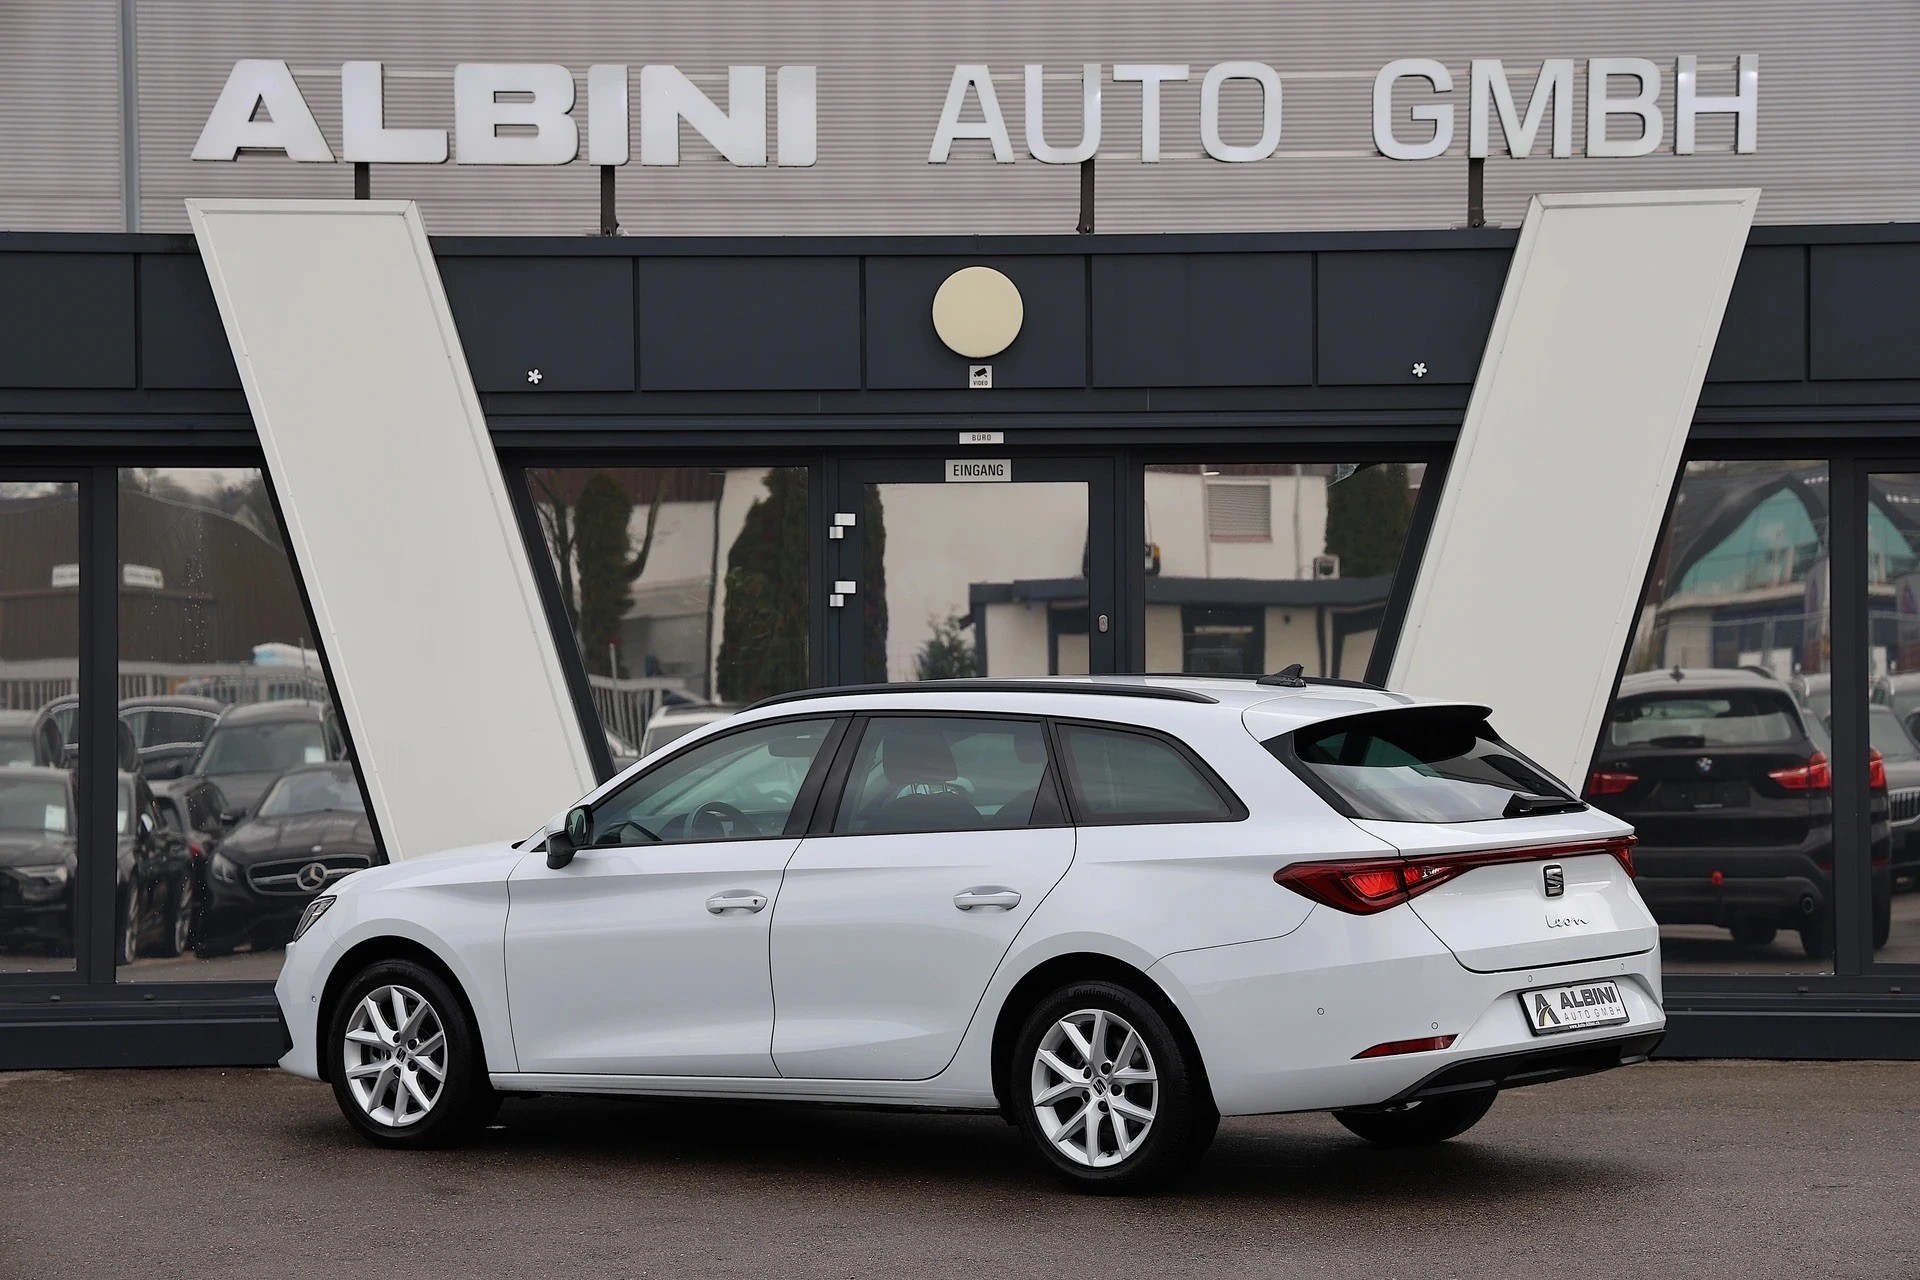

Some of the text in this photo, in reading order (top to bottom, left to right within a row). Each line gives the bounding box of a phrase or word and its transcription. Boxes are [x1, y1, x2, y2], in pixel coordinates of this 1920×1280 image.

[190, 53, 1760, 167] ALBINI AUTO GMBH
[953, 464, 1004, 476] EINGANG
[1560, 986, 1617, 1009] ALBINI
[1564, 1006, 1622, 1022] AUTO GMBH
